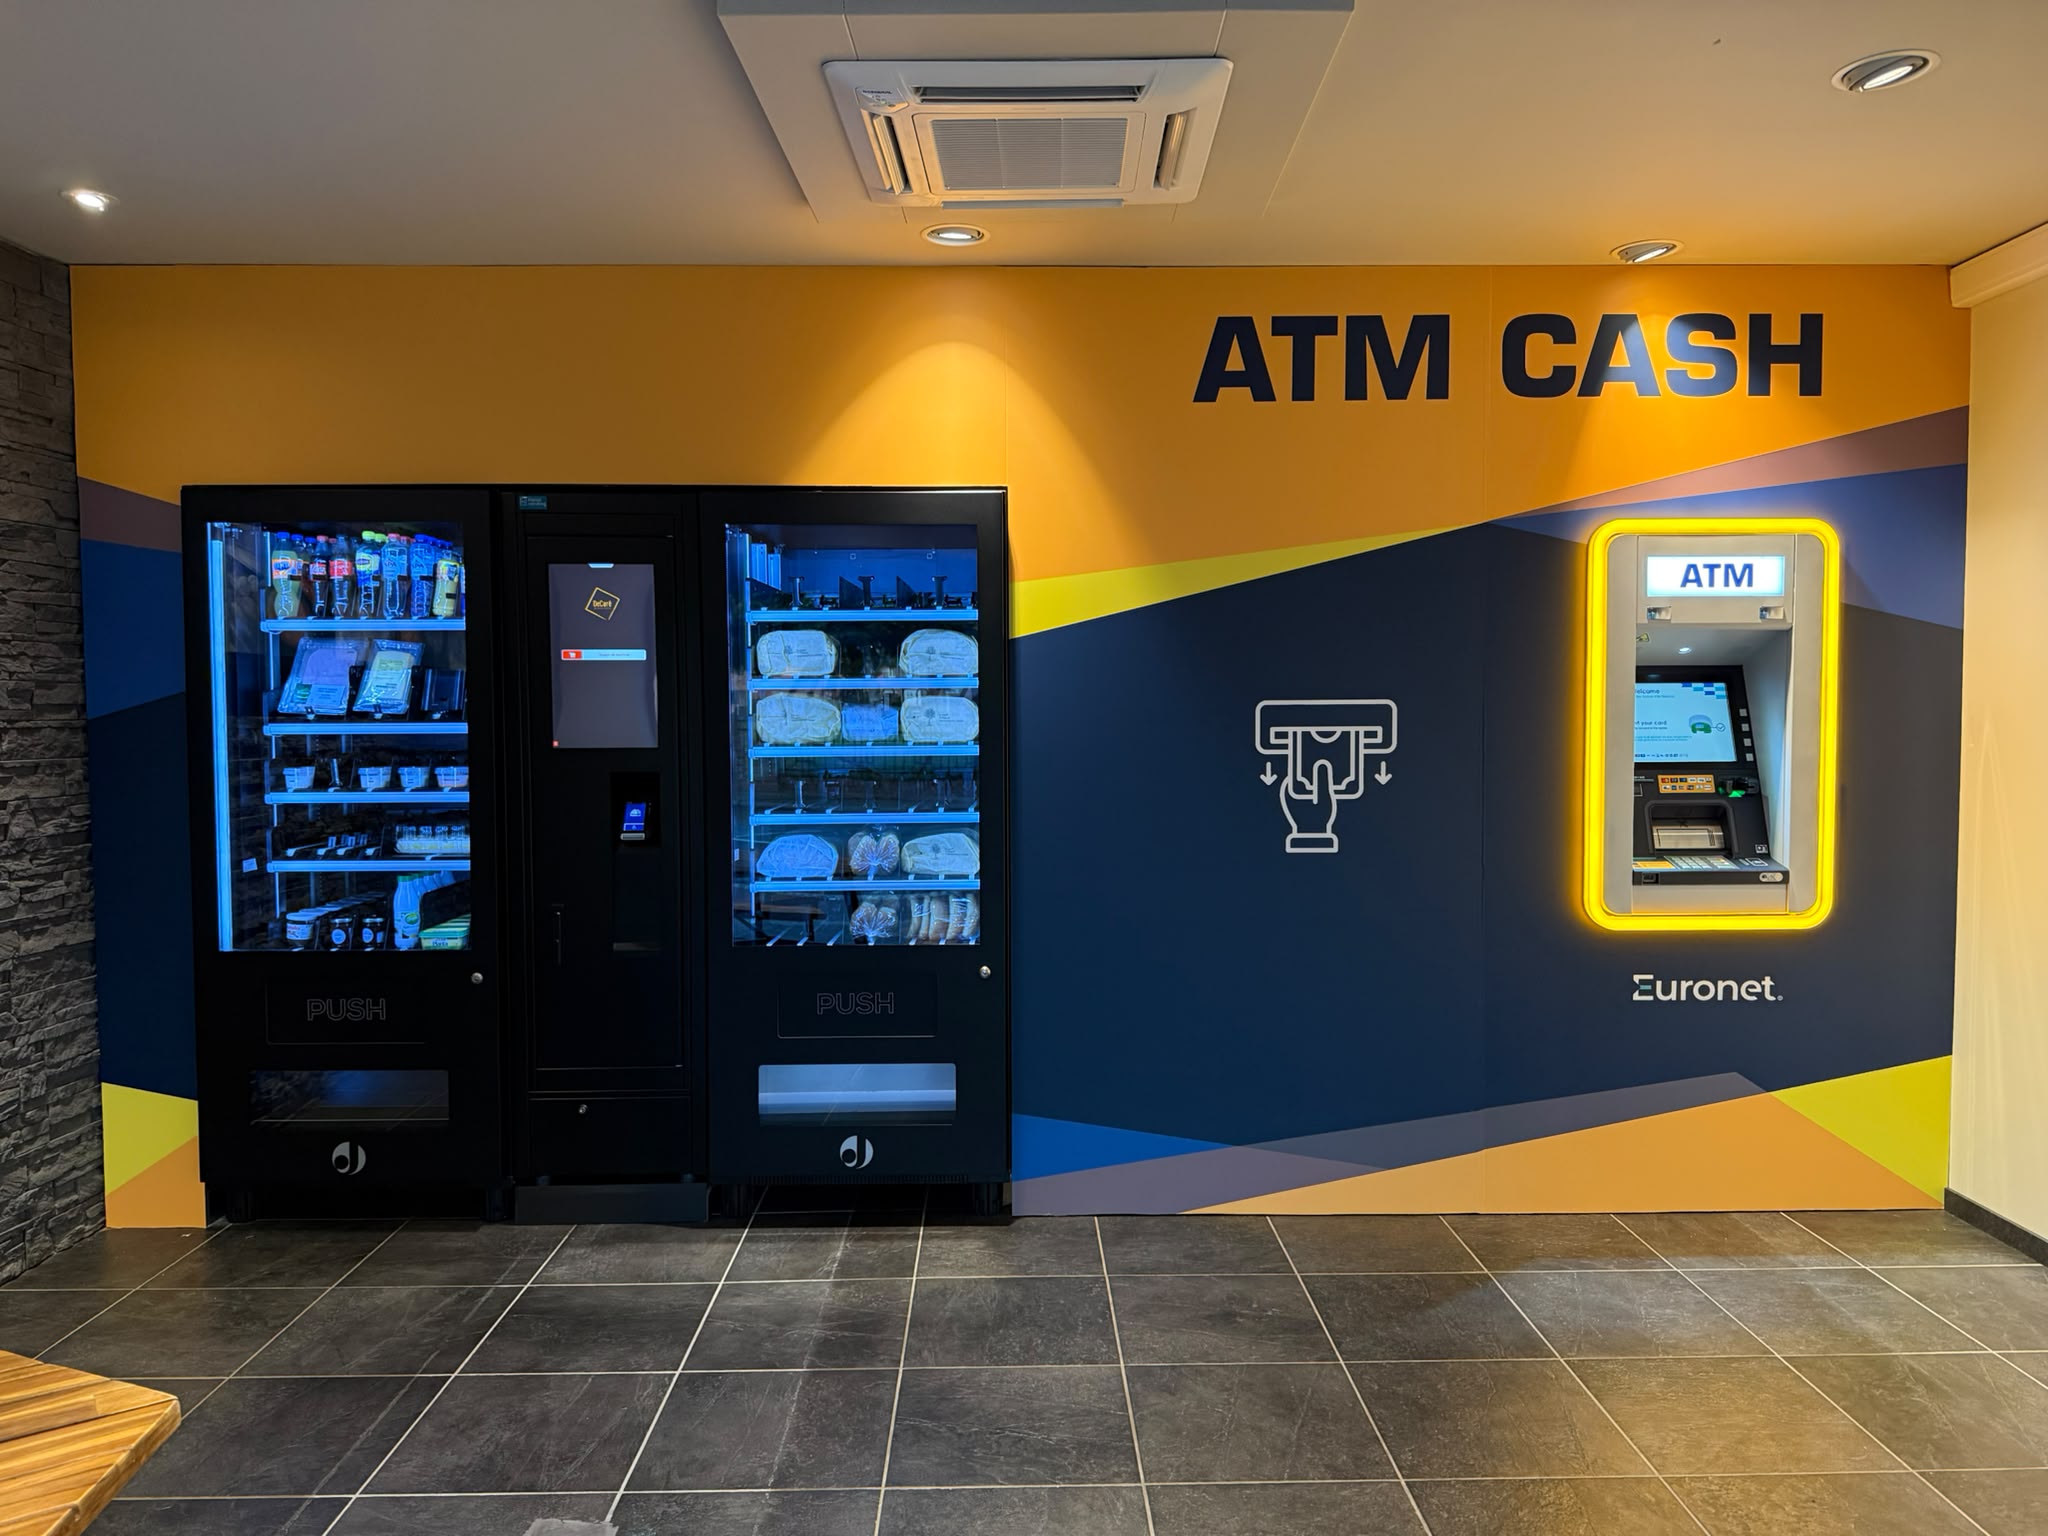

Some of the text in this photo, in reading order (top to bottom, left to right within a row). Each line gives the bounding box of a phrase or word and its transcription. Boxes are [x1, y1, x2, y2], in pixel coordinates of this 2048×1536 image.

[1192, 313, 1824, 403] ATM CASH
[1680, 563, 1754, 588] ATM
[306, 998, 386, 1021] PUSH
[816, 992, 895, 1015] PUSH
